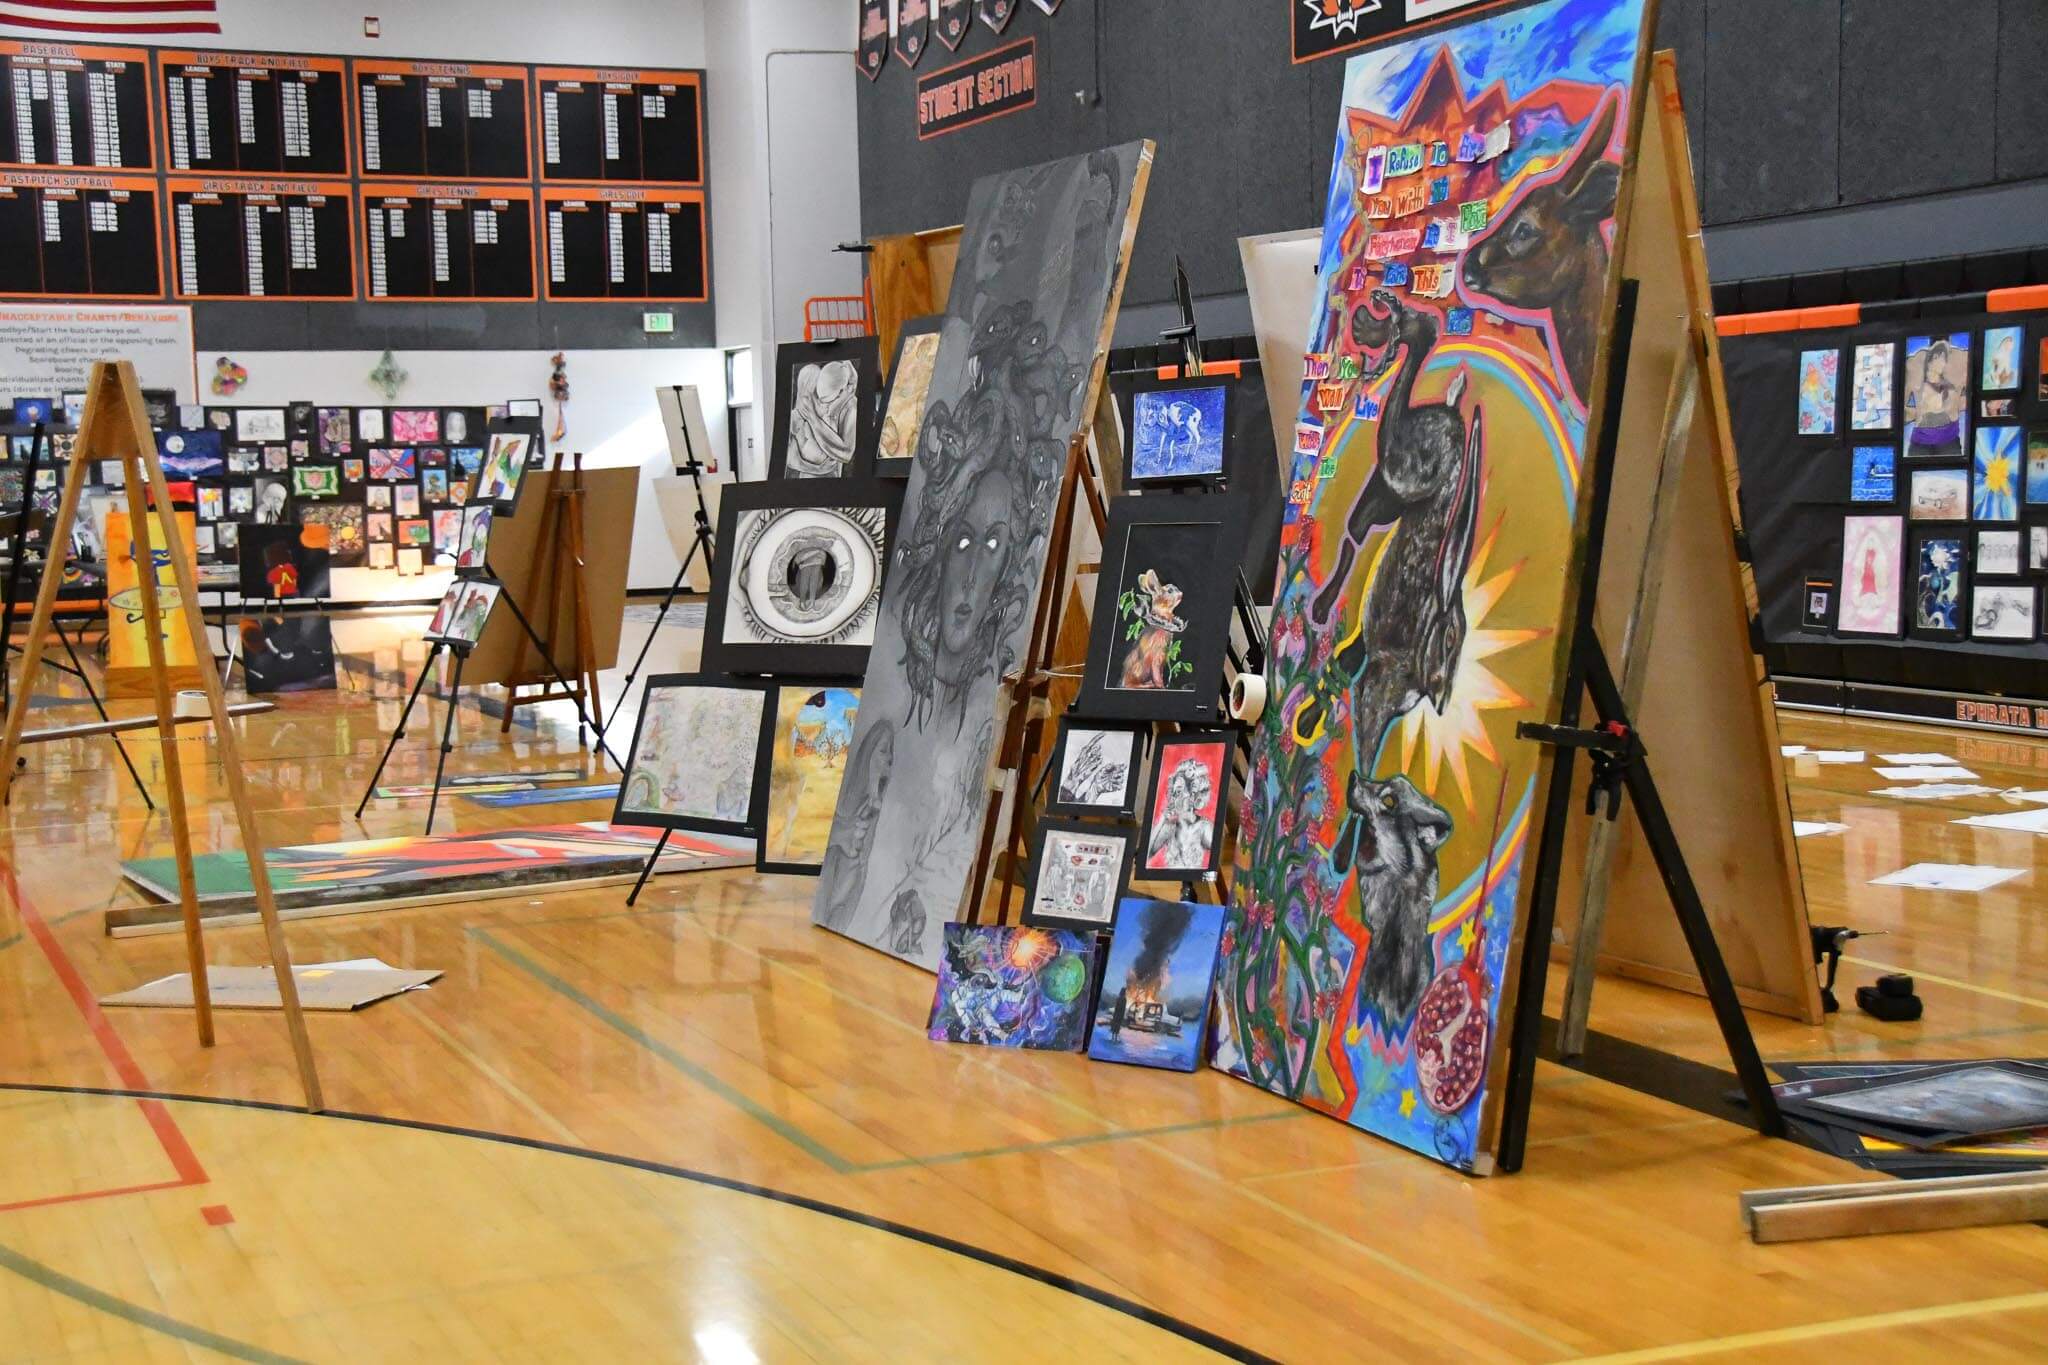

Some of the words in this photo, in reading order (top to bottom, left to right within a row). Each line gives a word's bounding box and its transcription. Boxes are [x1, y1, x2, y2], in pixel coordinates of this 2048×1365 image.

[23, 44, 76, 57] BASEBALL
[196, 55, 221, 64] BOYS
[224, 56, 256, 66] TRACK
[261, 58, 279, 67] AND
[439, 64, 471, 75] TENNIS
[919, 75, 975, 125] STUDENT
[977, 54, 1034, 106] SECTION
[1368, 155, 1383, 188] I
[1388, 147, 1420, 174] Refuse
[3, 174, 60, 185] FASTPITCH
[63, 177, 113, 188] SOFTBALL
[235, 183, 265, 193] TRACK
[270, 184, 289, 193] AND
[446, 187, 479, 197] TENNIS
[1370, 197, 1392, 217] You
[1414, 268, 1440, 290] This
[649, 314, 669, 330] EXIT
[16, 346, 58, 355] Degrading
[1303, 356, 1329, 379] Then
[1318, 387, 1345, 409] Will
[1355, 393, 1379, 419] Live
[1956, 700, 2031, 728] EPHRATA
